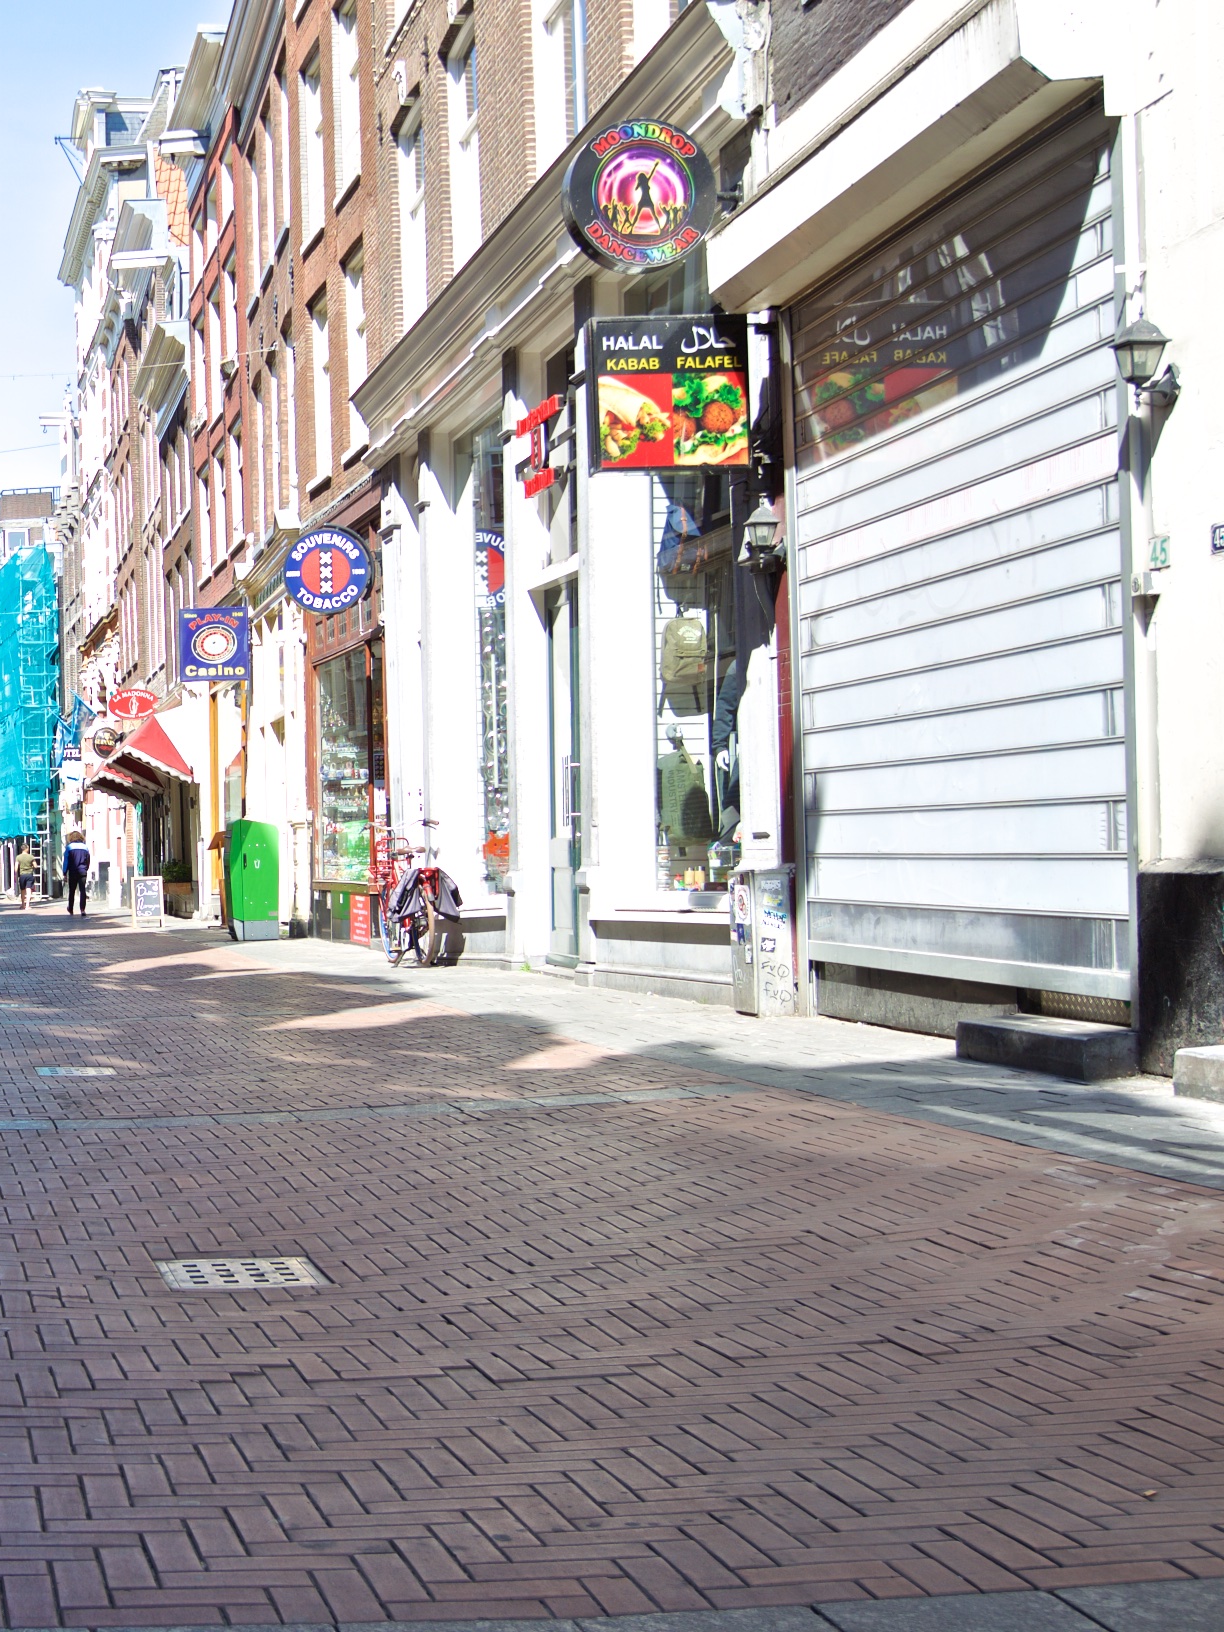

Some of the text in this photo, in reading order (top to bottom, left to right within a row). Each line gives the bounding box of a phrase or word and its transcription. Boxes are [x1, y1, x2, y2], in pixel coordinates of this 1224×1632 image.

[591, 123, 696, 157] MOONDROP
[586, 221, 700, 263] DANCEWEAR
[602, 335, 663, 351] HALAL
[606, 355, 742, 371] KABAB FALAFEL
[291, 533, 360, 561] SOUVENIRS
[1150, 538, 1168, 568] 45
[297, 587, 359, 609] TOBACCO
[188, 613, 240, 631] PLAY-IN
[185, 664, 246, 677] Casino
[112, 690, 154, 703] LA MADONNA
